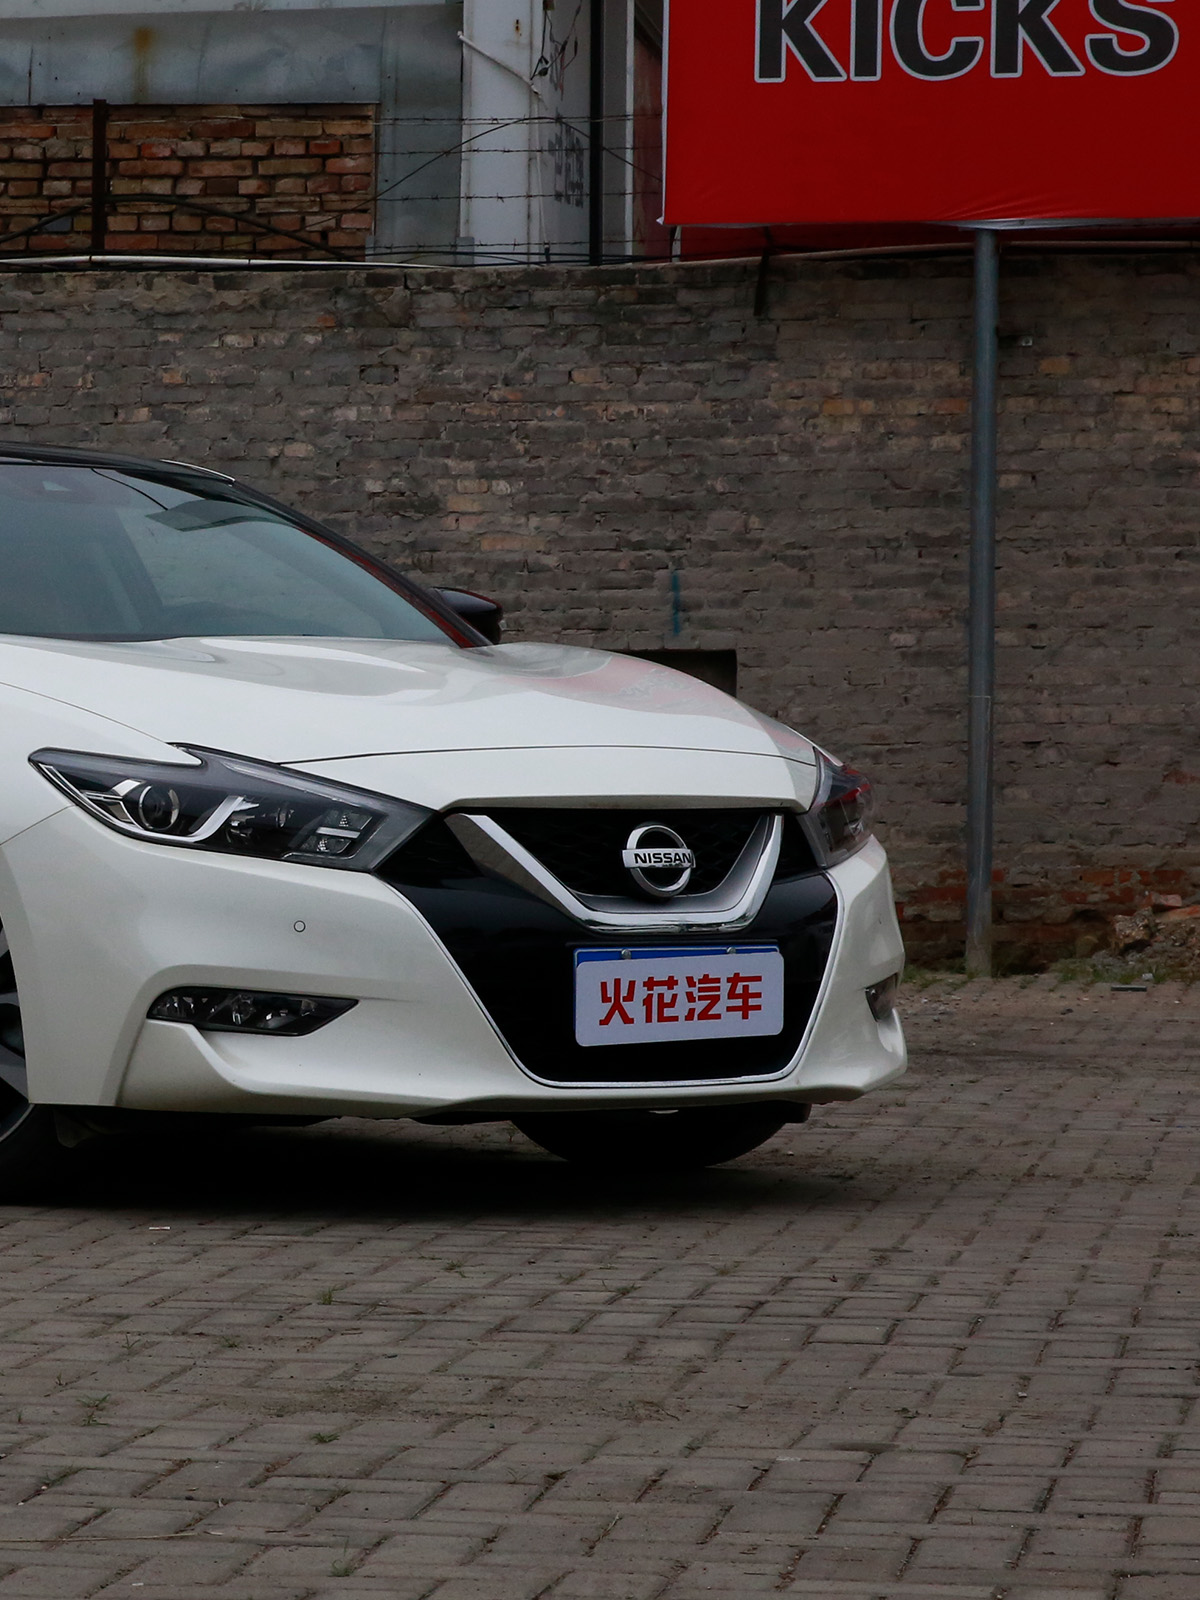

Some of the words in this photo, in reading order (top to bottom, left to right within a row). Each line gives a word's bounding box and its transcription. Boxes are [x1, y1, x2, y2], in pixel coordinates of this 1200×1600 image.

[754, 0, 1179, 82] KICKS
[634, 852, 692, 865] NISSAN
[598, 972, 763, 1026] 火花汽车
